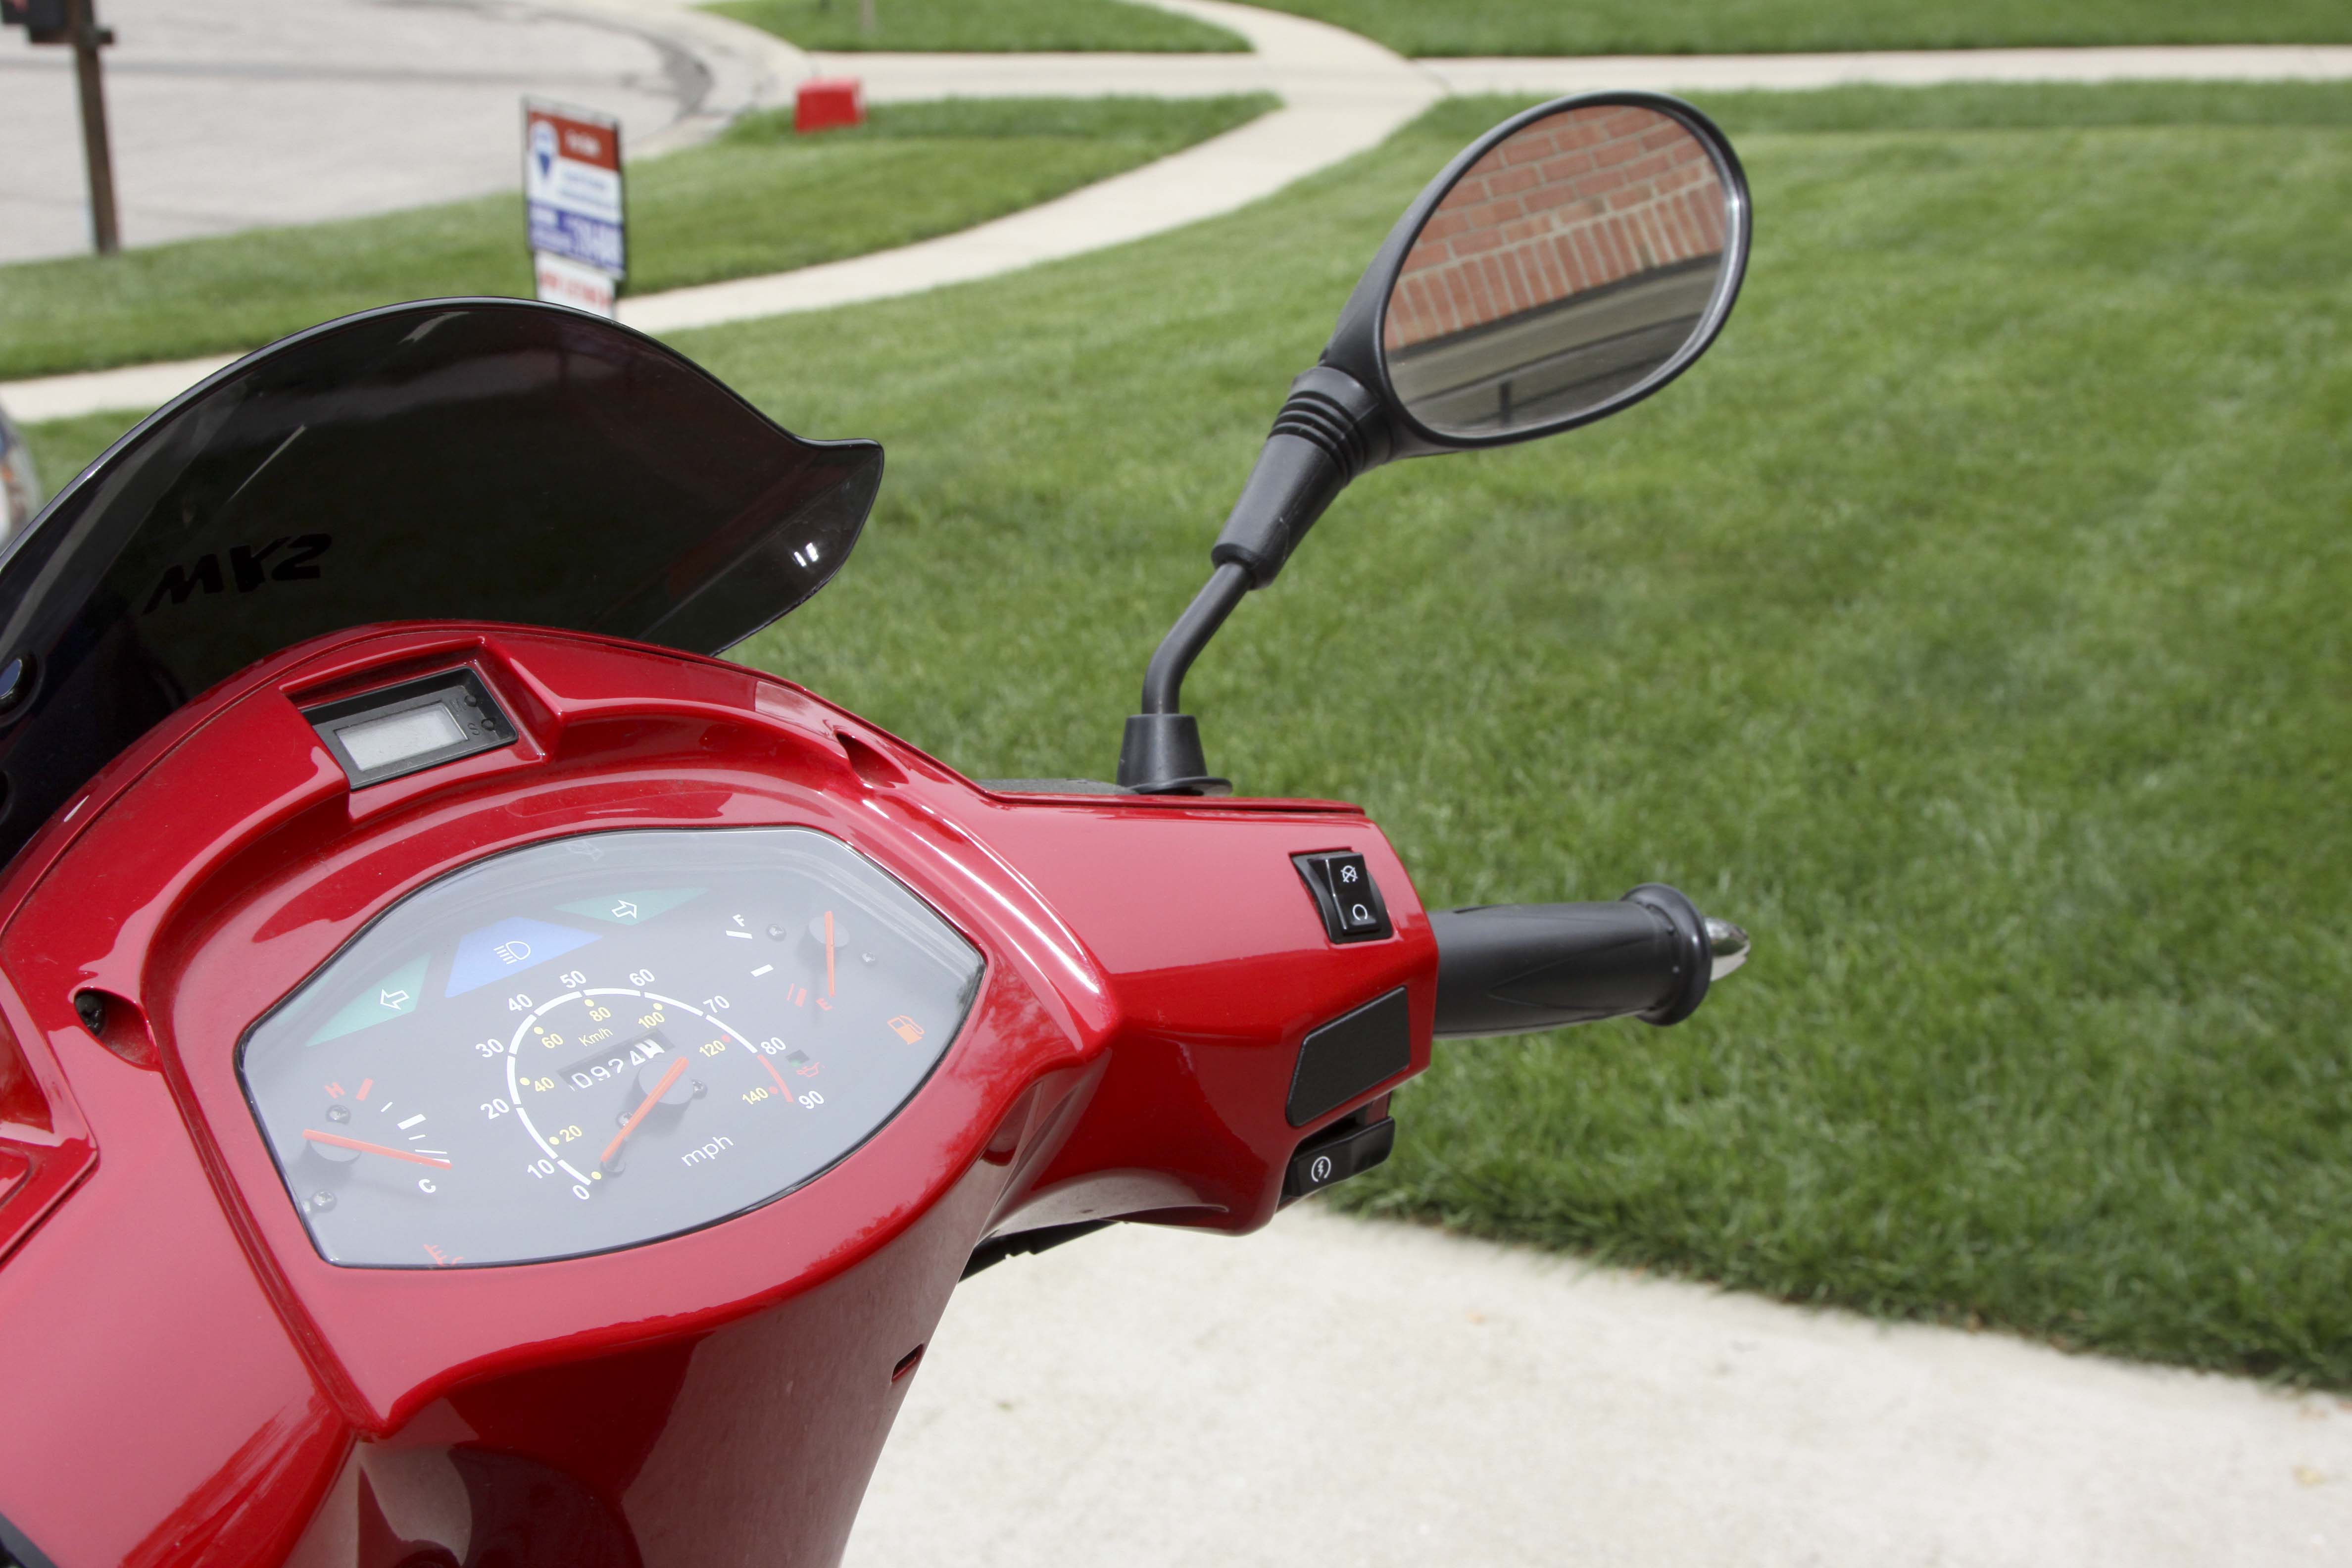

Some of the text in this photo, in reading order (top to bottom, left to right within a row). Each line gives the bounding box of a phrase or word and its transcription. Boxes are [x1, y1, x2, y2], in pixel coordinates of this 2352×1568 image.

[733, 914, 746, 927] F
[560, 971, 586, 988] 50
[630, 969, 655, 986] 60
[509, 994, 533, 1011] 40
[703, 996, 730, 1013] 70
[816, 998, 833, 1011] E
[589, 1007, 611, 1021] 80
[638, 1011, 664, 1028] 100
[541, 1033, 563, 1048] 60
[578, 1029, 613, 1046] Km/h
[760, 1037, 785, 1055] 80
[476, 1039, 504, 1057] 30
[699, 1040, 726, 1057] 120
[325, 1082, 344, 1098] H
[535, 1078, 554, 1091] 40
[742, 1088, 768, 1104] 140
[799, 1091, 824, 1109] 90
[481, 1098, 509, 1119] 20
[560, 1126, 582, 1142] 20
[682, 1137, 734, 1166] mph
[528, 1159, 555, 1178] 10
[419, 1179, 436, 1193] C
[573, 1185, 590, 1199] 0
